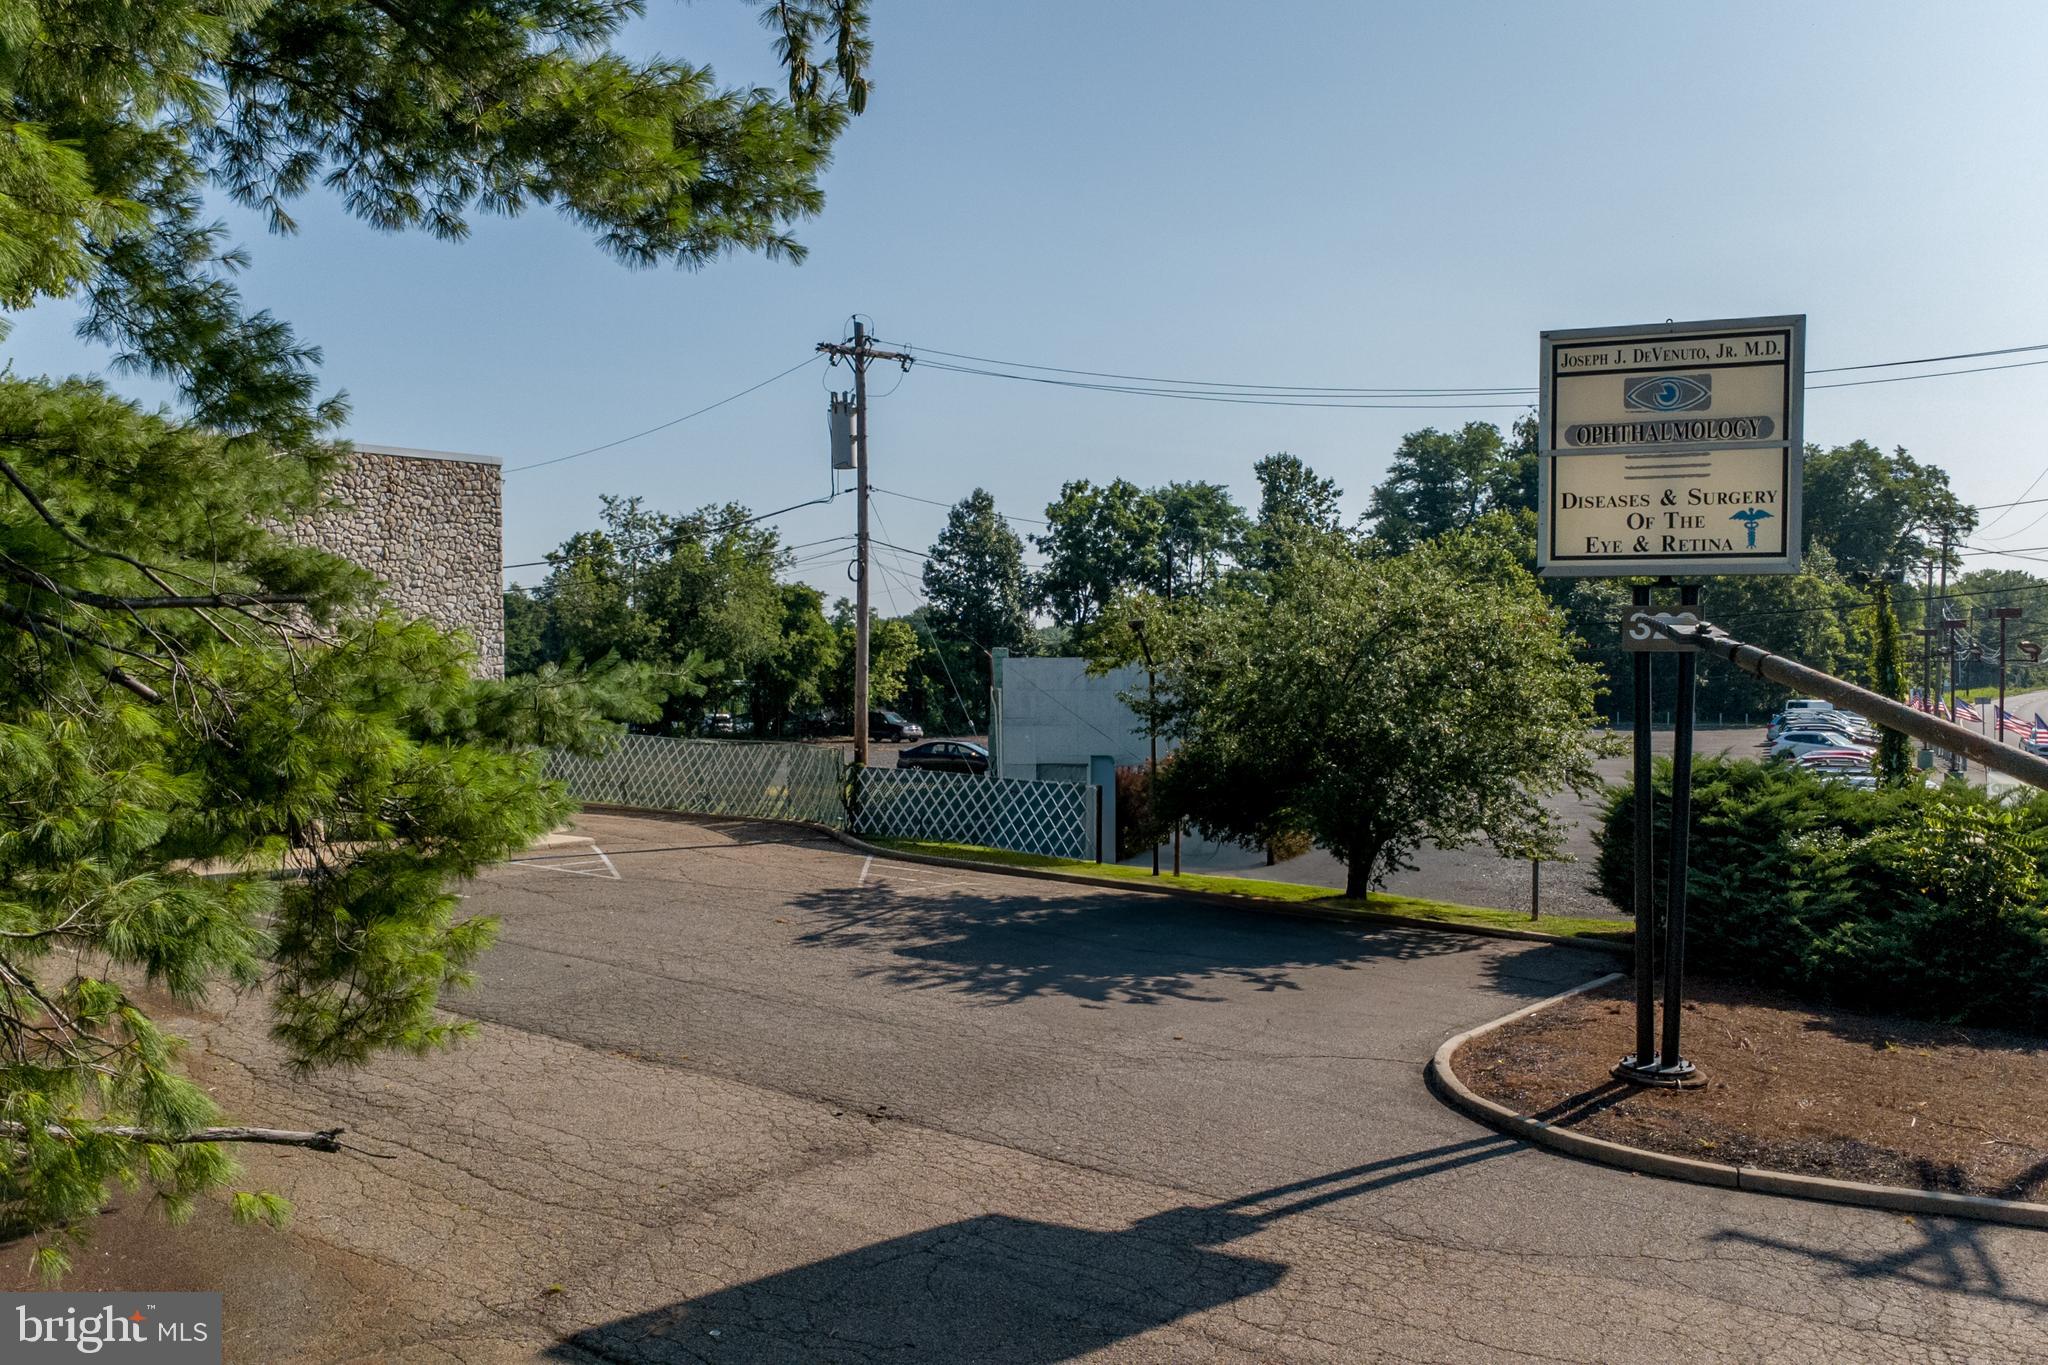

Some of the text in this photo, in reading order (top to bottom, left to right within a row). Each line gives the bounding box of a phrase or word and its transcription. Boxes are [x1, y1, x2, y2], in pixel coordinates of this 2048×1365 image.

[1614, 351, 1626, 364] J.
[1745, 340, 1781, 356] M.D.
[1576, 417, 1762, 445] OPHTHALMOLOGY
[1660, 489, 1677, 506] &
[1632, 535, 1649, 552] &
